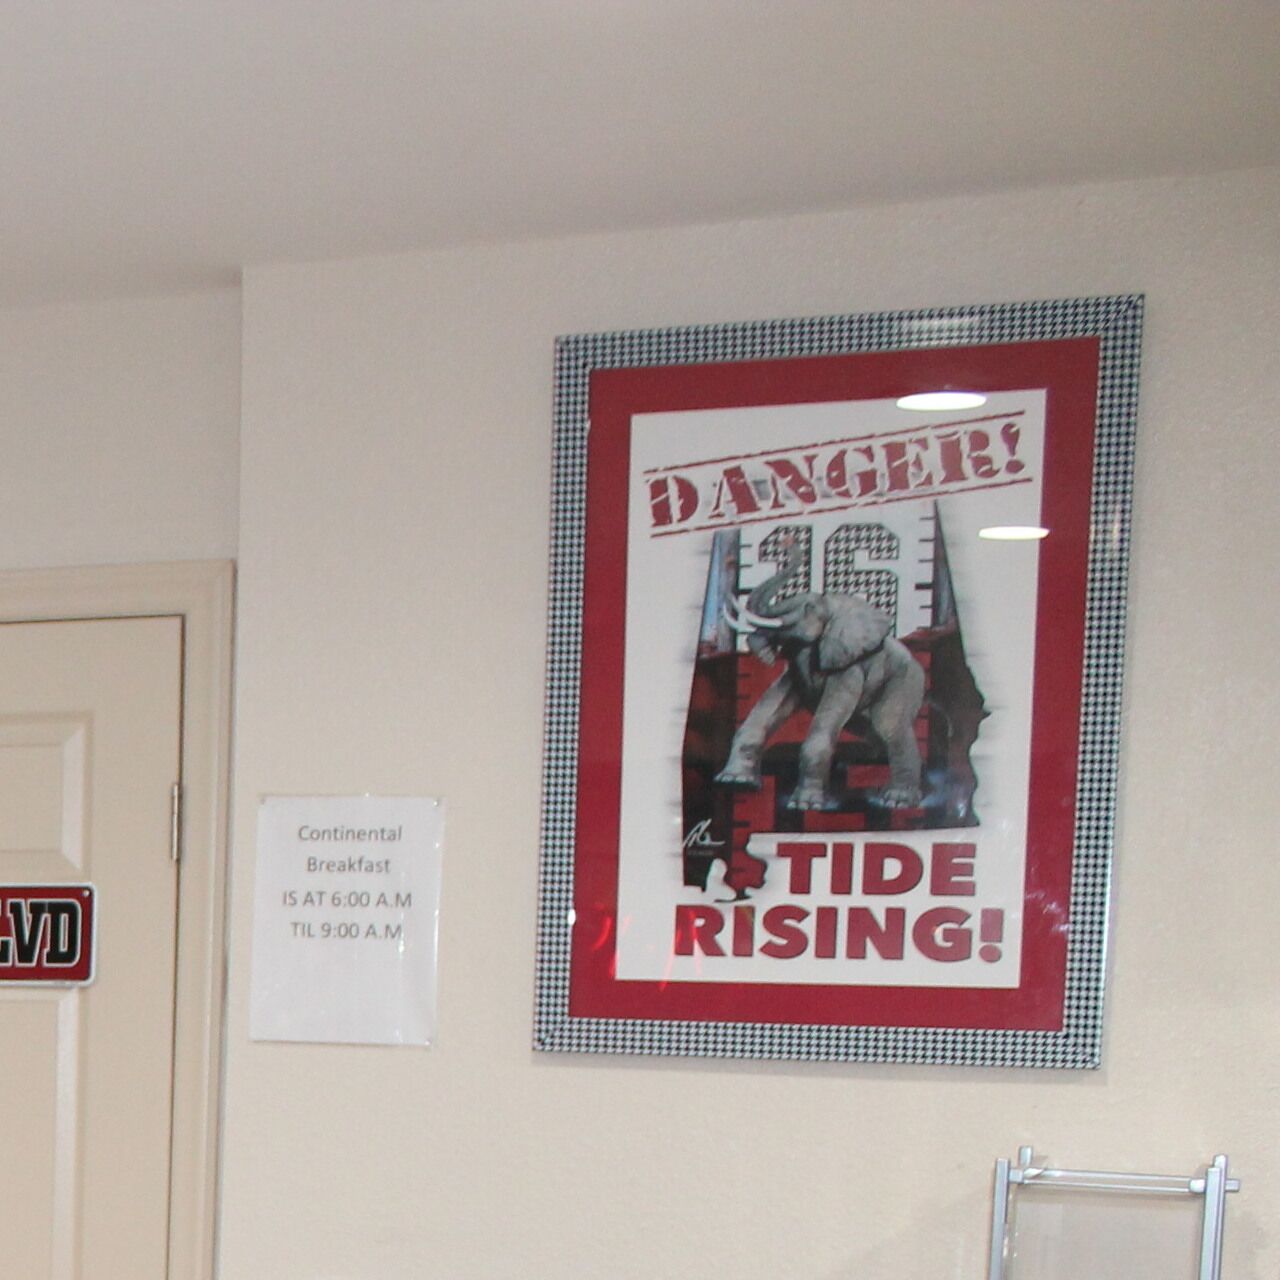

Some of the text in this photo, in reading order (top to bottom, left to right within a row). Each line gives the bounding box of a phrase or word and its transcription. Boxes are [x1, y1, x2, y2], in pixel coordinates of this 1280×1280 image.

[645, 421, 1025, 528] DANGER!
[297, 824, 403, 842] Continental
[306, 856, 391, 874] Breakfast
[777, 842, 977, 896] TIDE
[282, 890, 412, 909] IS AT 6:00 A.M
[290, 922, 403, 940] TIL 9:00 A.M
[675, 904, 1005, 963] RISING!
